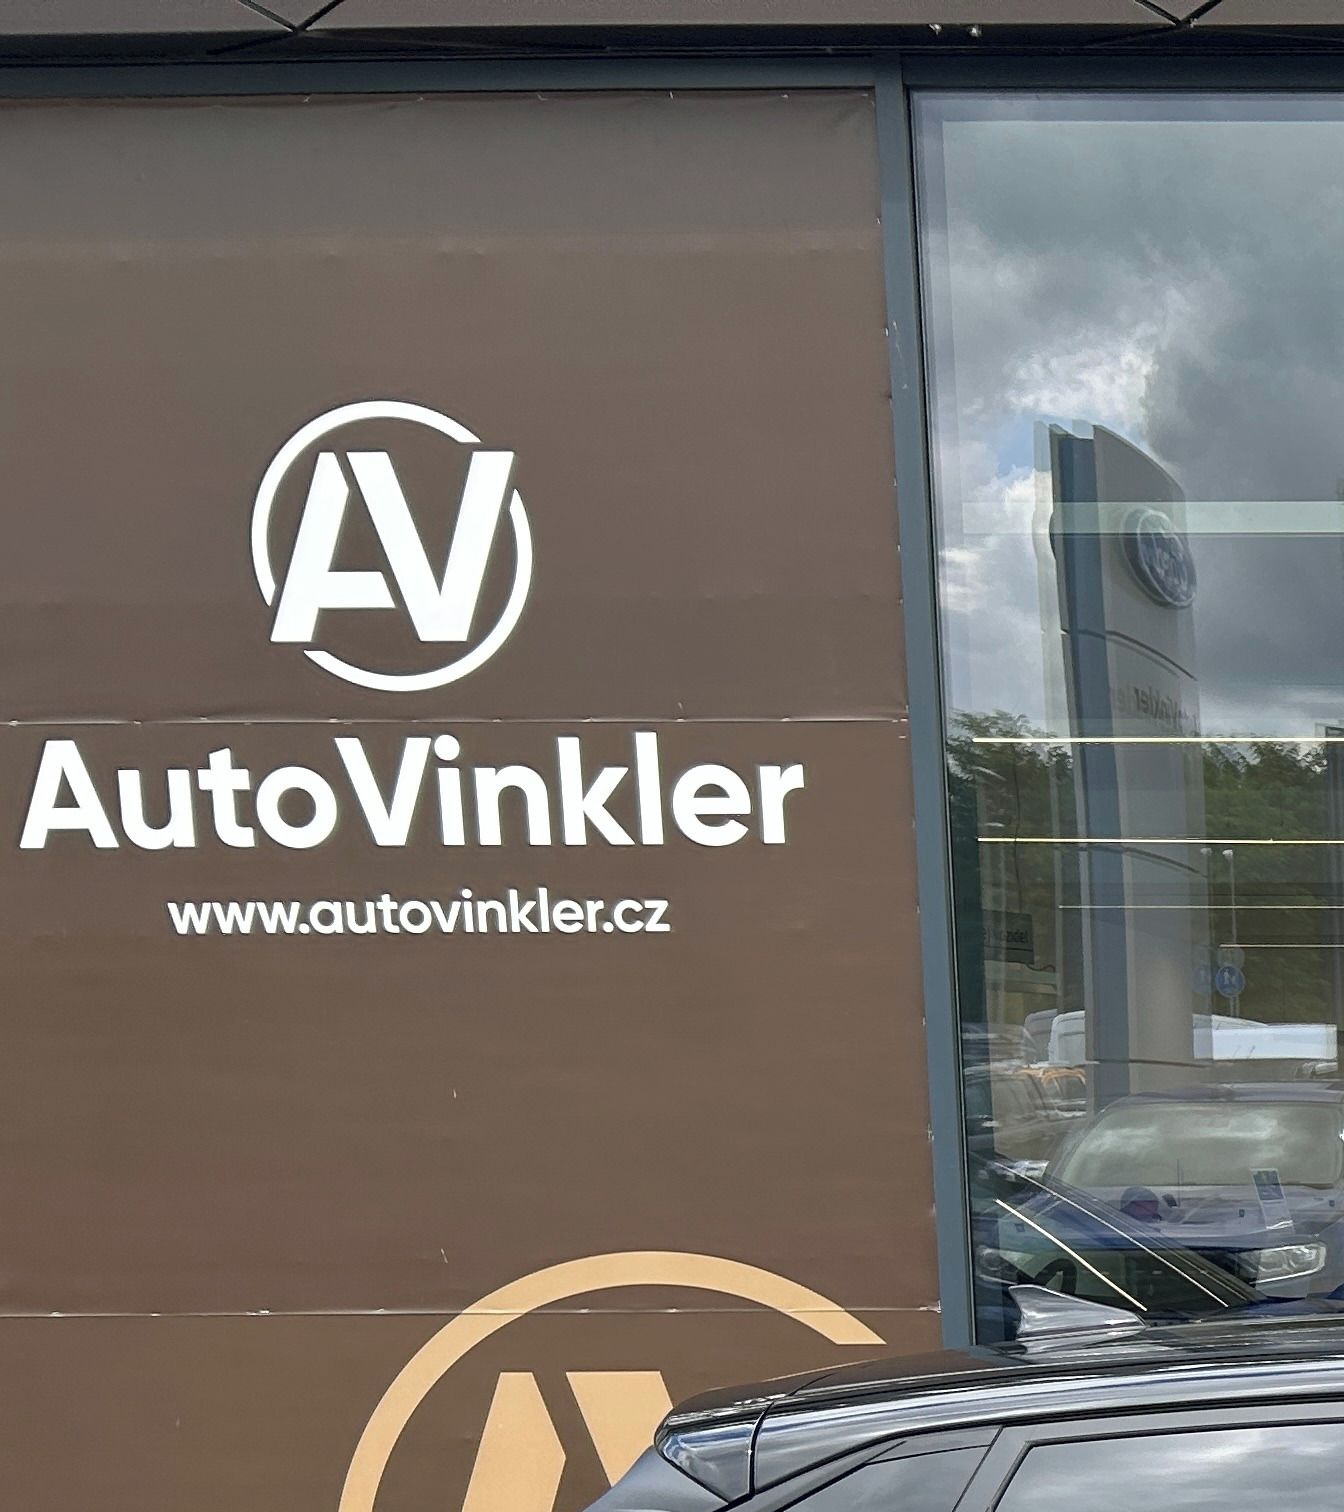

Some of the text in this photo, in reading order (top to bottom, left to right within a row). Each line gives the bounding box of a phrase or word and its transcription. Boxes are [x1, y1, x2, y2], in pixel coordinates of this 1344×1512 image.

[271, 450, 516, 642] AV
[19, 731, 804, 850] AutoVinkler
[167, 887, 671, 935] www.autovinkler.cz
